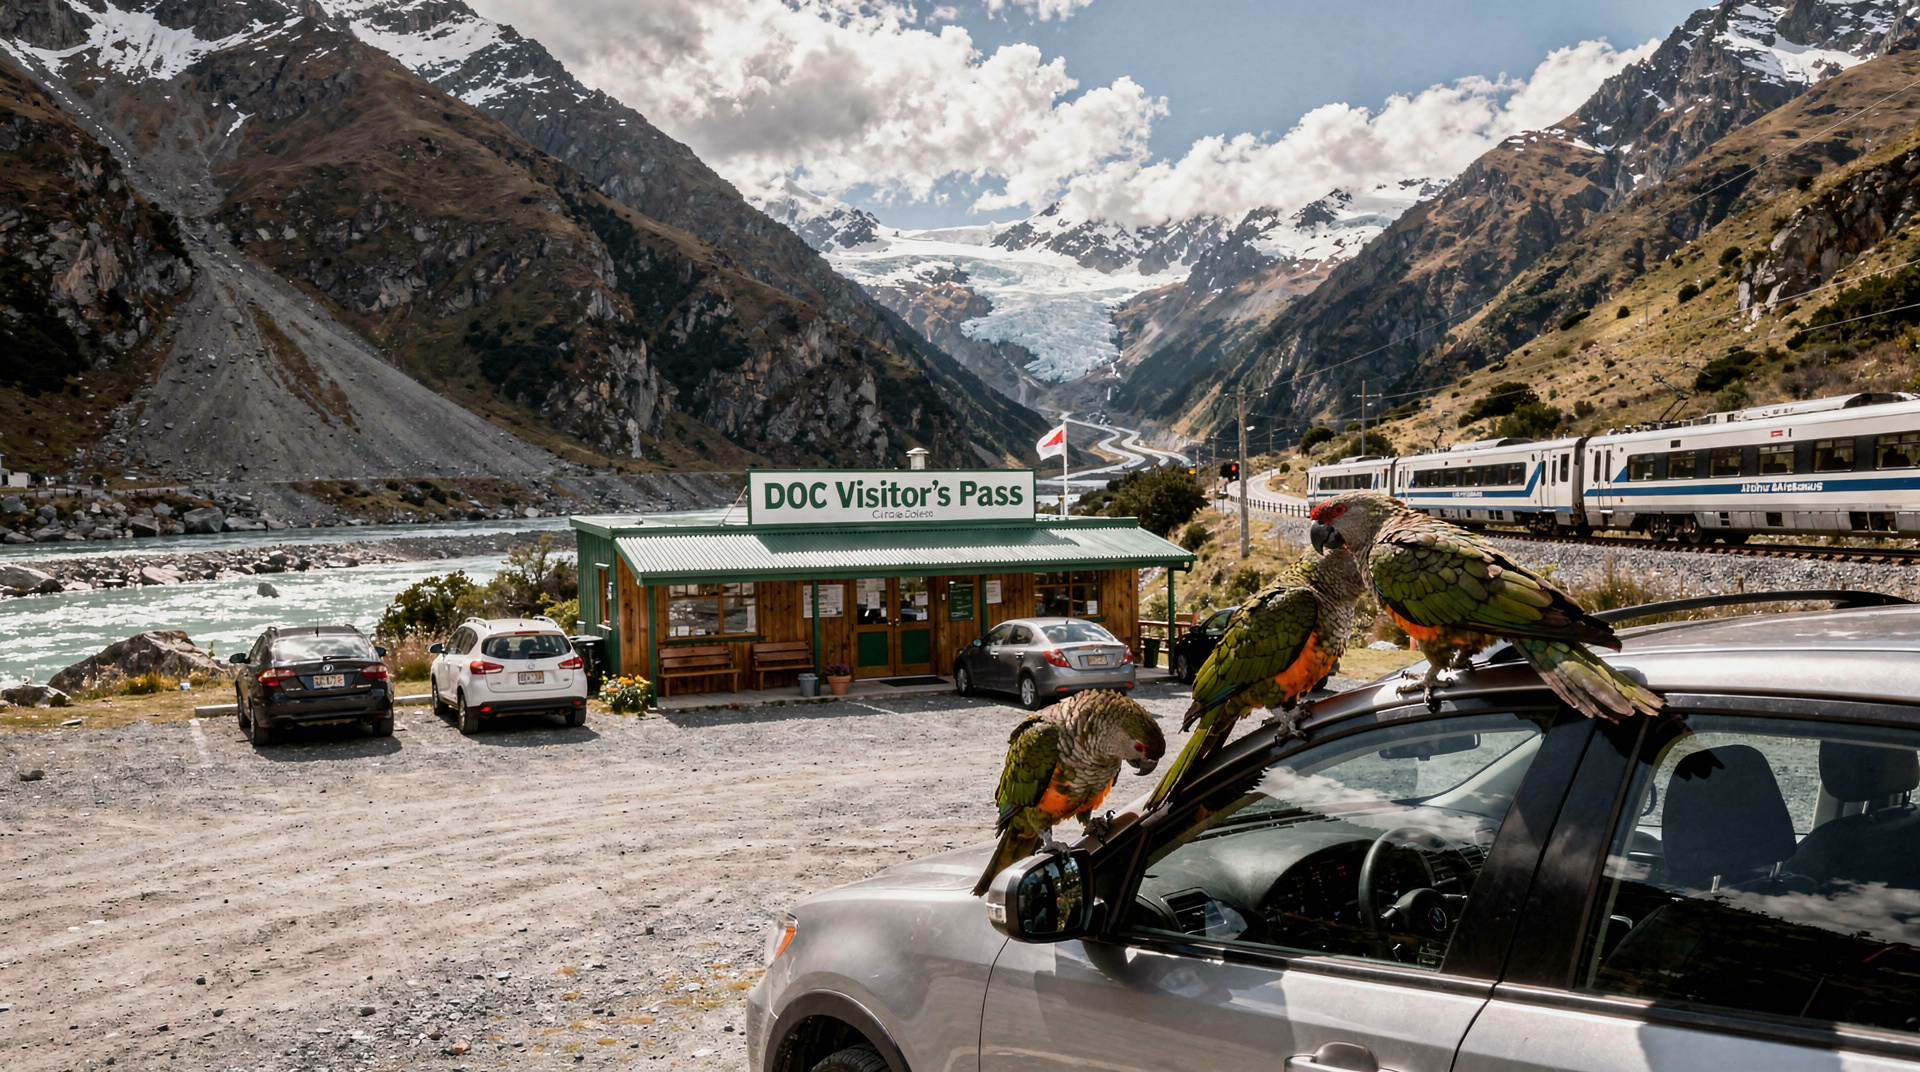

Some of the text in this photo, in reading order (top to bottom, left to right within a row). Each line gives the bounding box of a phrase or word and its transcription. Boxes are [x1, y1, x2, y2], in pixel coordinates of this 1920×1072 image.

[764, 479, 1024, 510] DOC Visitor's Pass
